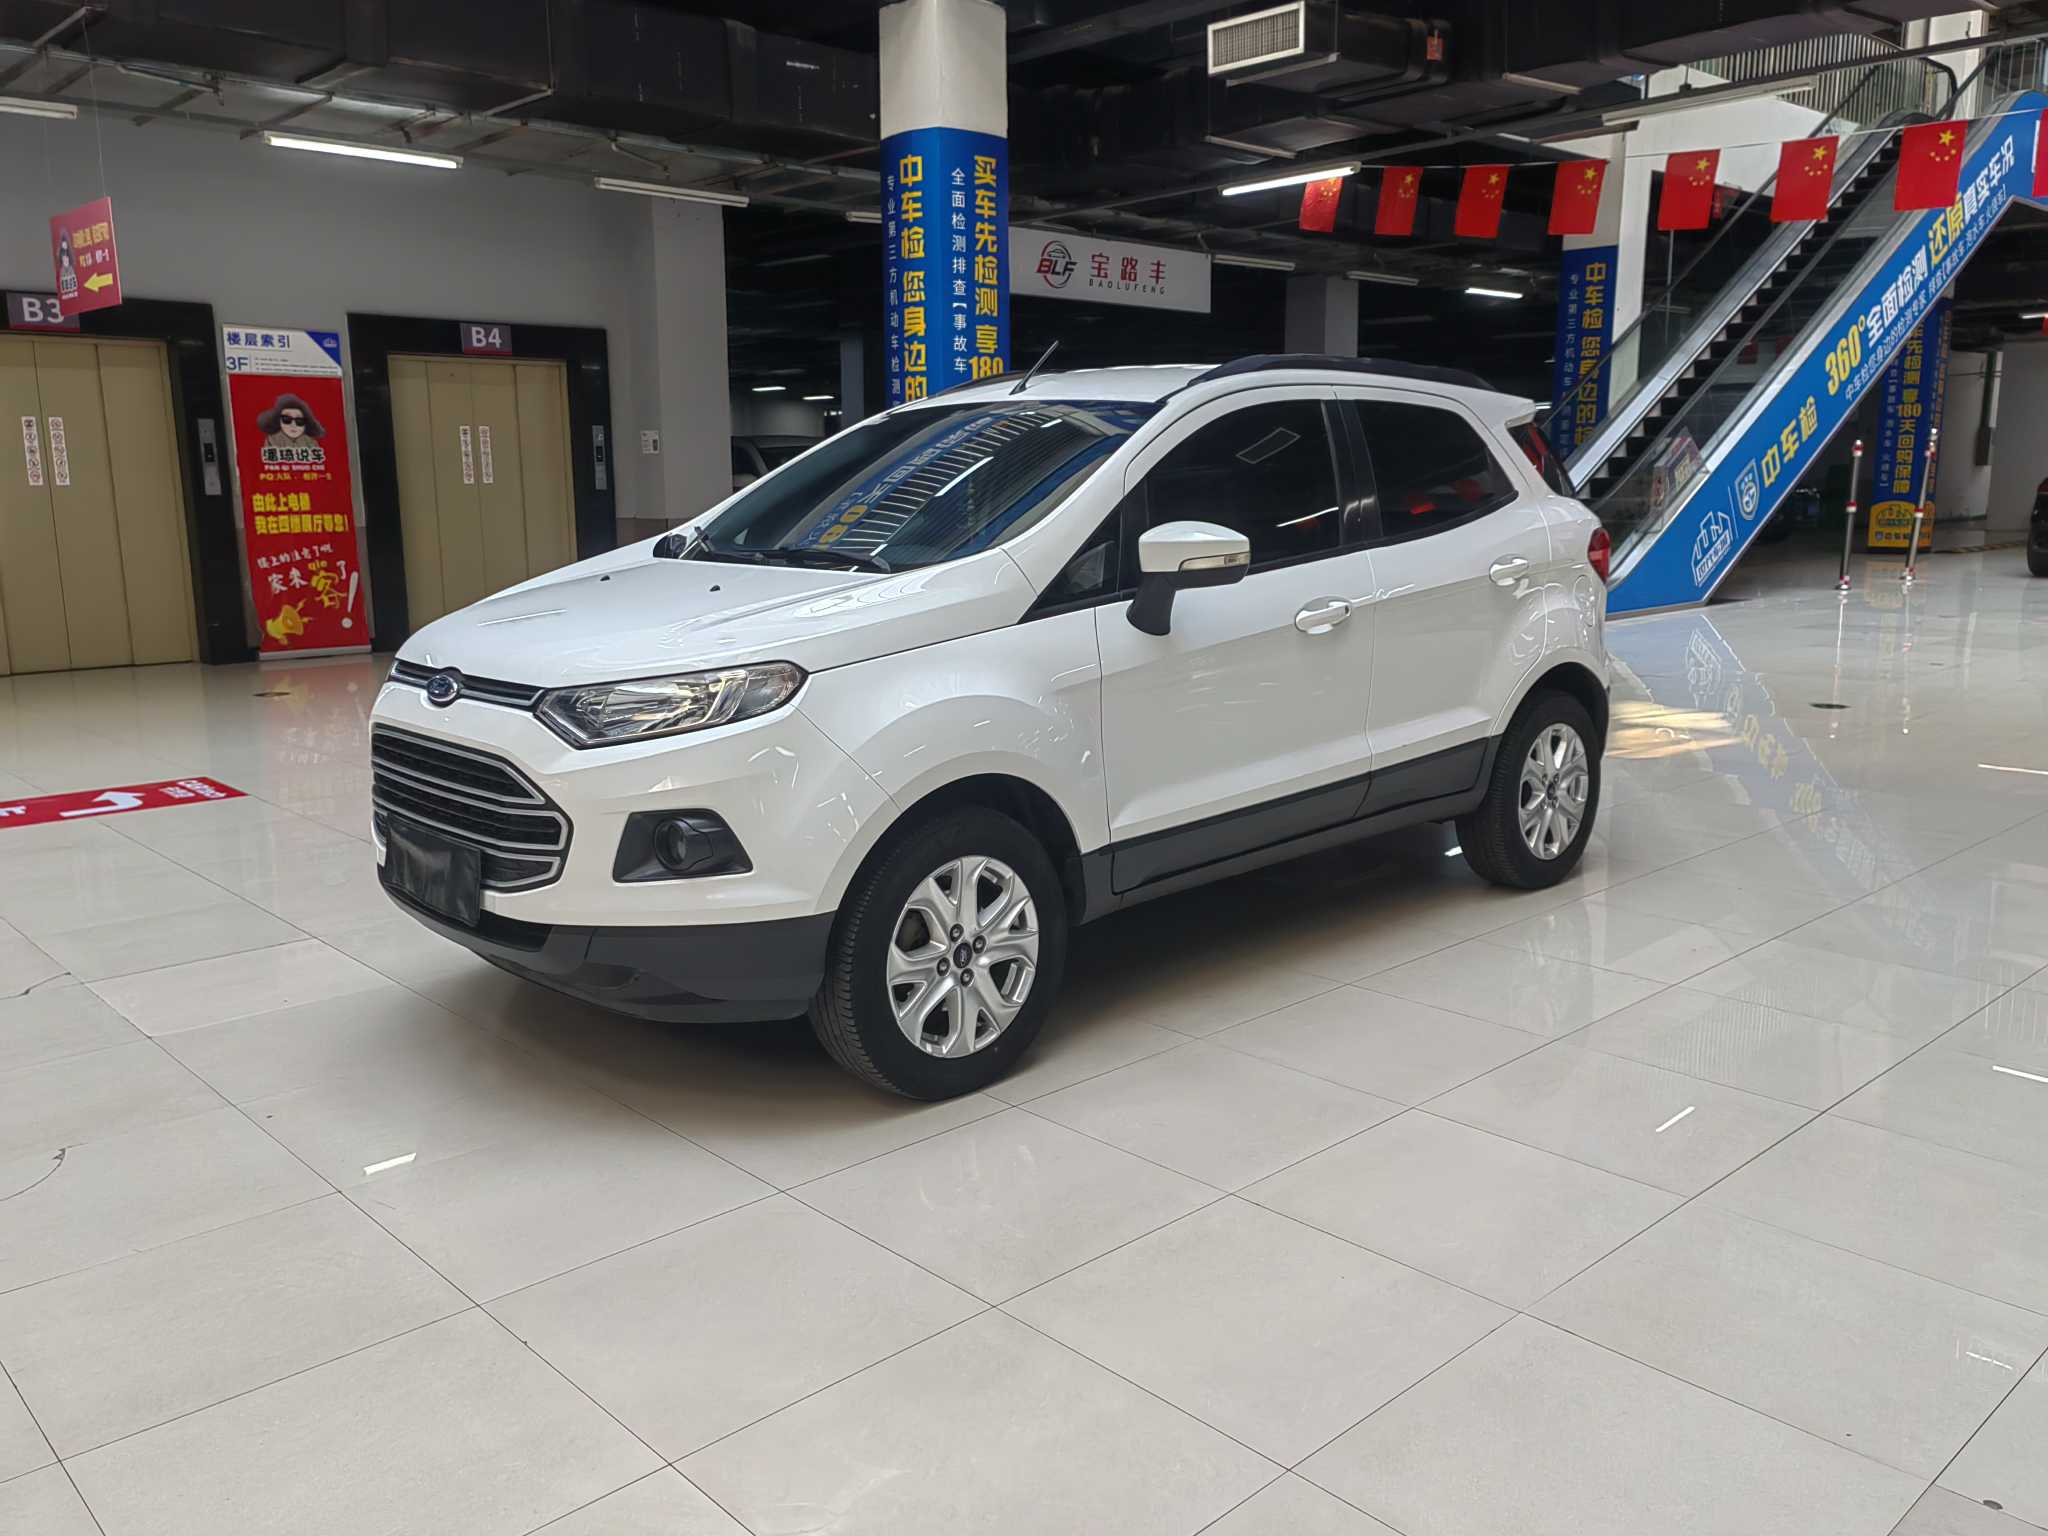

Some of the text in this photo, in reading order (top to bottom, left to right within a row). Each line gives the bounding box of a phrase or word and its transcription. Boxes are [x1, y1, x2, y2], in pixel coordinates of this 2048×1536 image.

[1036, 258, 1077, 276] BLF
[1091, 252, 1166, 284] 宝路丰
[1089, 279, 1165, 295] BAOLUFENG
[22, 298, 64, 323] B3
[227, 331, 290, 349] 楼层索引
[471, 327, 502, 349] B4
[226, 356, 249, 371] 3F
[1761, 395, 1819, 488] 中车检
